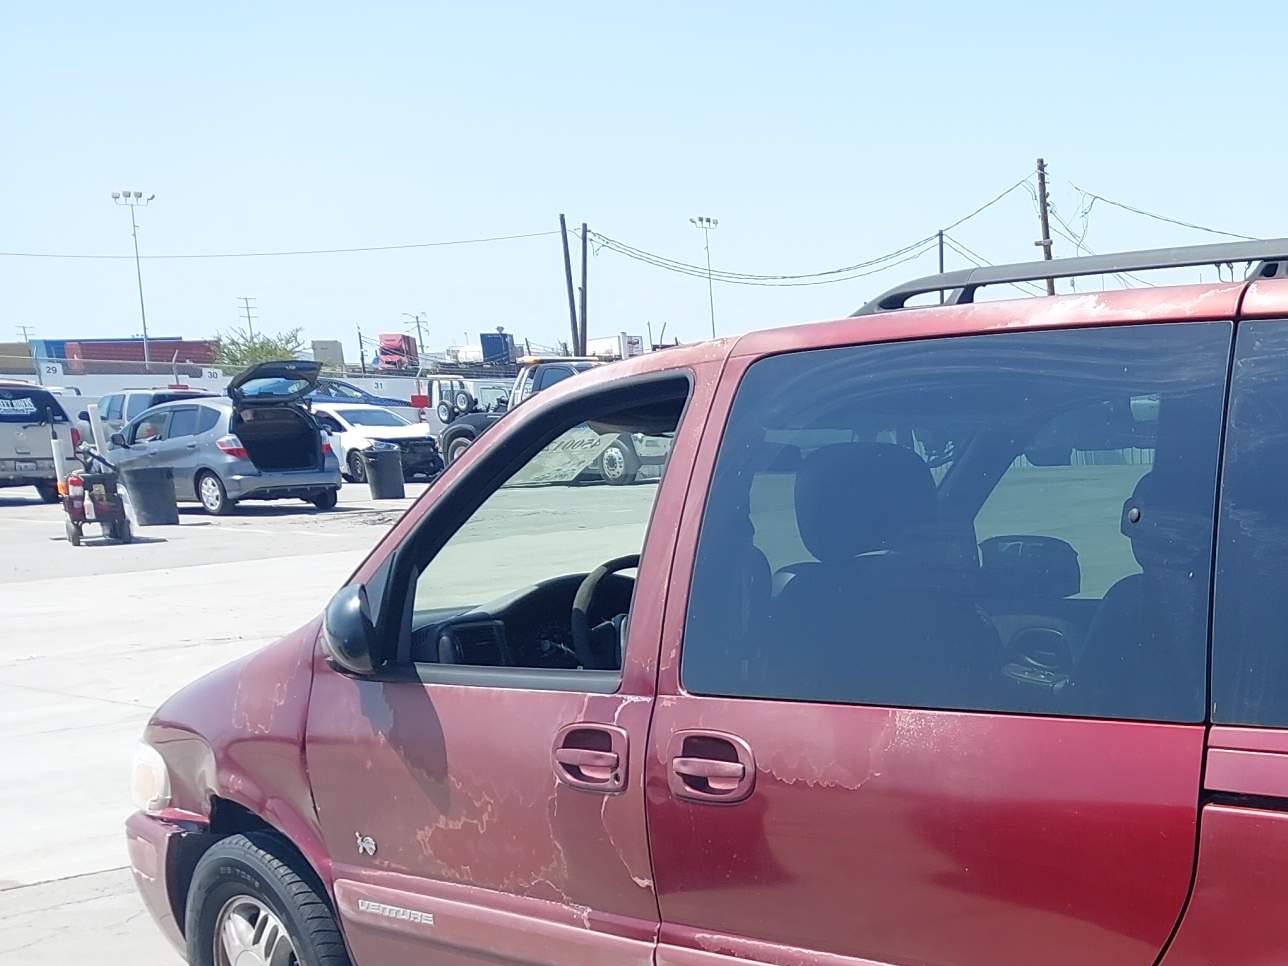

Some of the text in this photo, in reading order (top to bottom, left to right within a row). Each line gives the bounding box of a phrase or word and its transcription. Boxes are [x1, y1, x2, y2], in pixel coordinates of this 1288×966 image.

[46, 366, 57, 375] 29
[207, 371, 218, 380] 30
[359, 900, 434, 925] VENTURE
